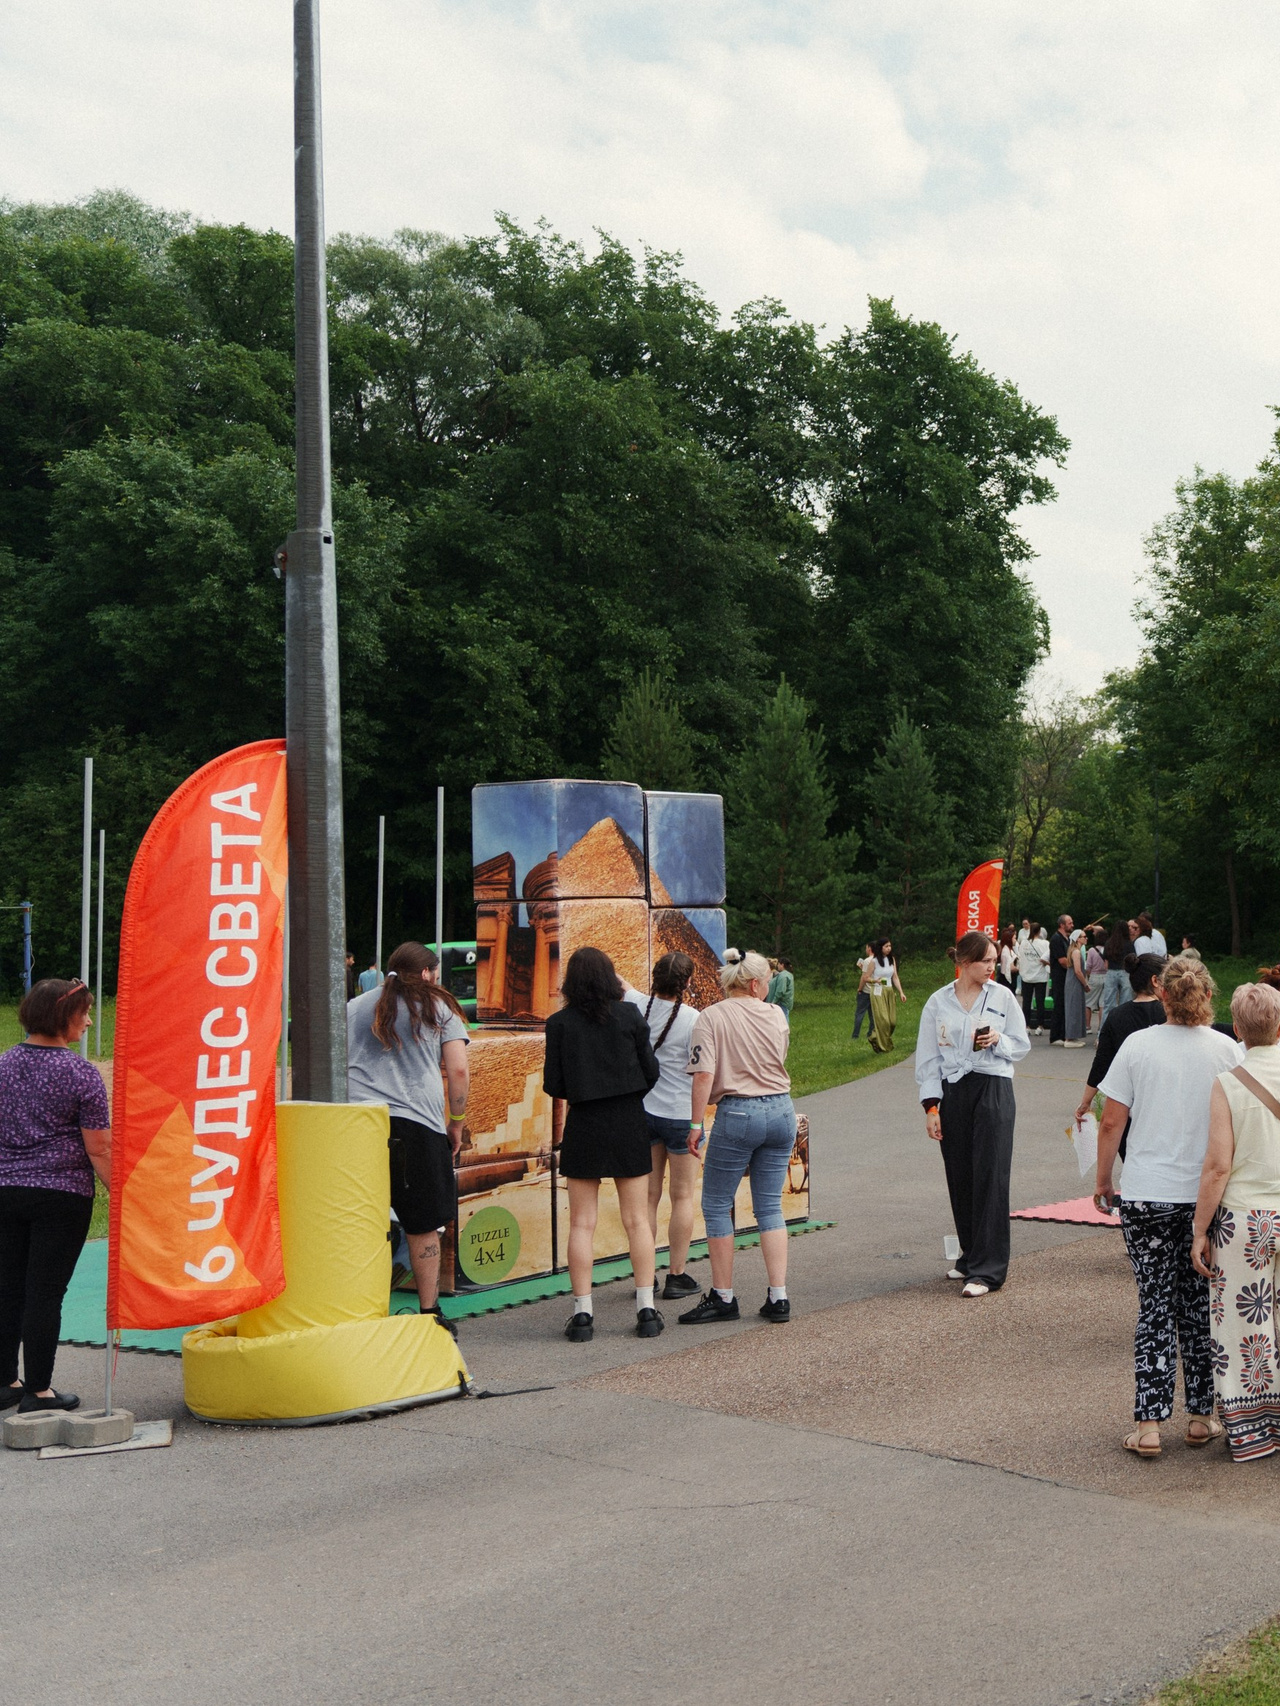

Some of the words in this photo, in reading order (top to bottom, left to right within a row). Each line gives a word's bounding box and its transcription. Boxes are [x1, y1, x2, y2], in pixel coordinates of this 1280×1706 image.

[206, 783, 261, 987] СВЕТА
[187, 1006, 257, 1232] ЧУДЕС
[470, 1227, 510, 1244] PUZZLE
[474, 1242, 505, 1266] 4x4
[184, 1245, 236, 1283] 6
